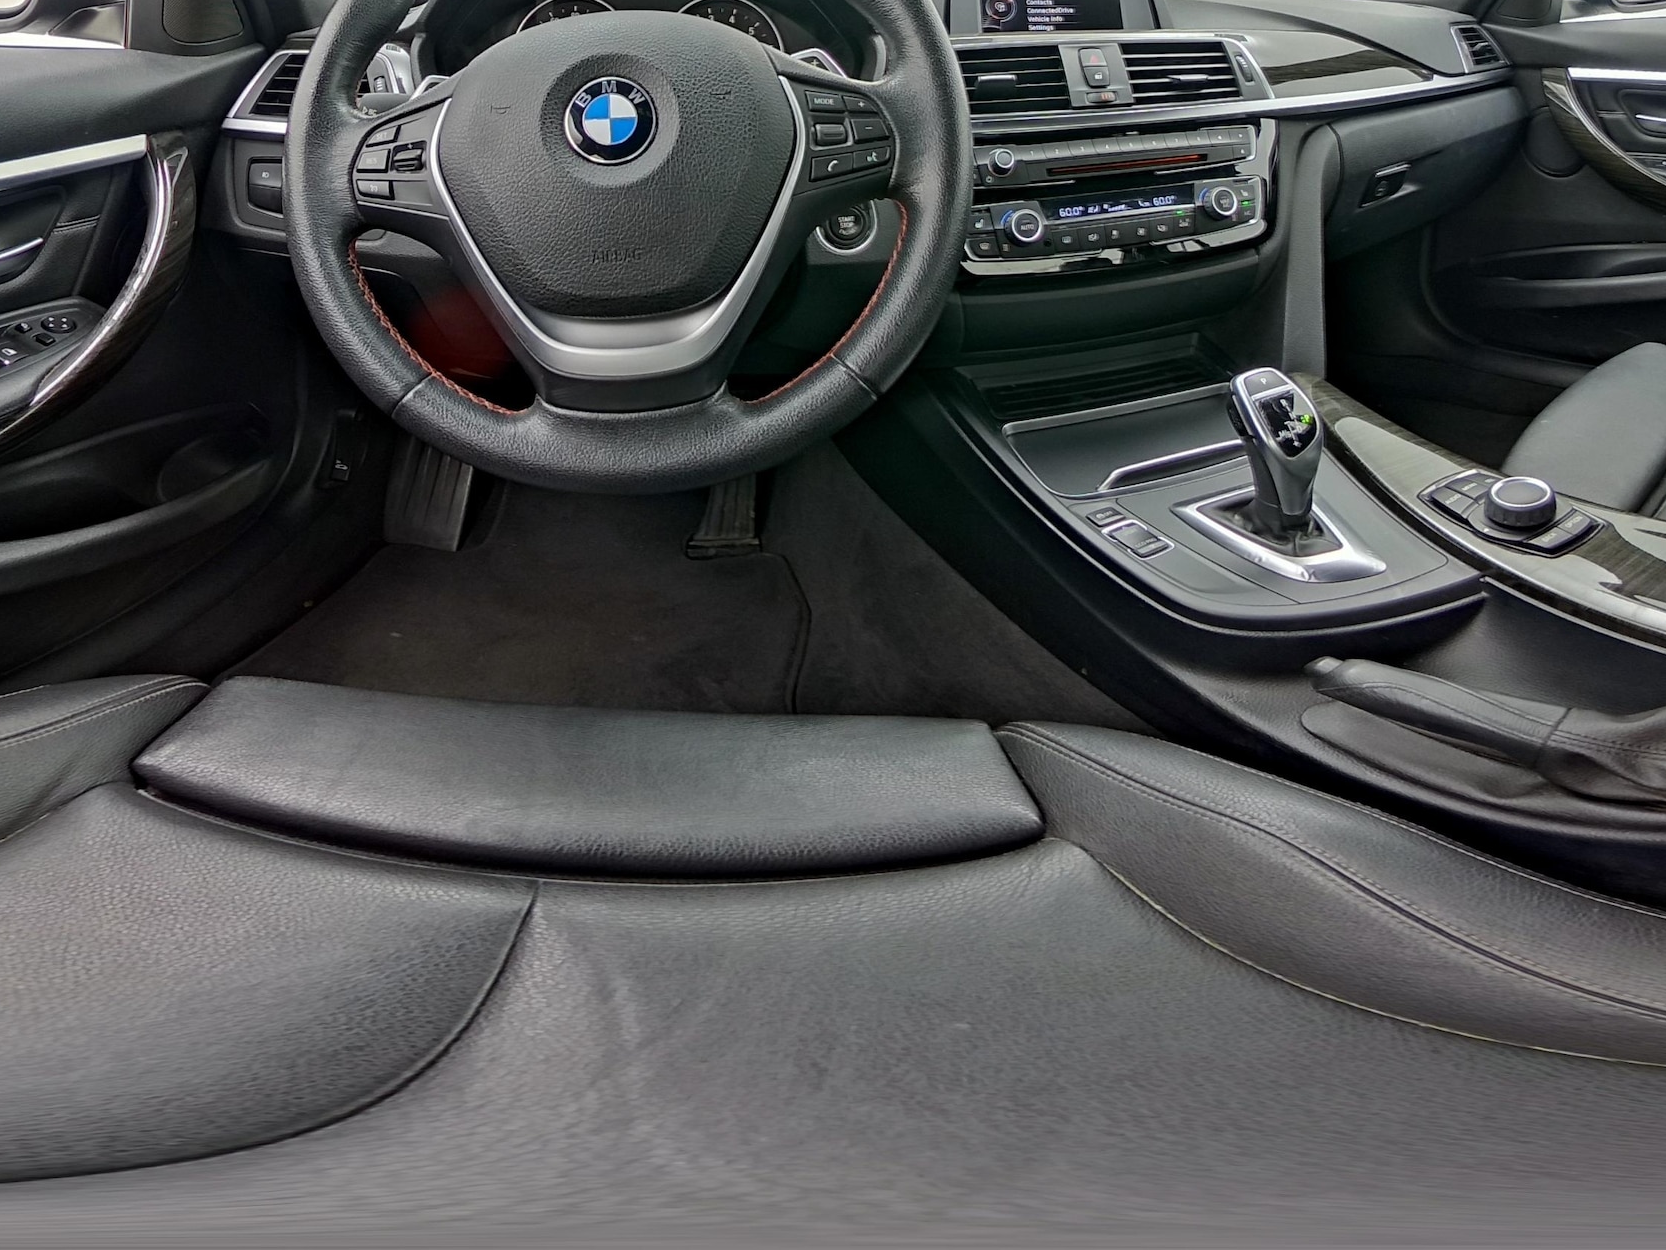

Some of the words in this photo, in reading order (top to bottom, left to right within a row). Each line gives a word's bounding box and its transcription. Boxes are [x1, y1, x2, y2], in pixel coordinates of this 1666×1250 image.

[728, 15, 735, 24] 4
[748, 27, 755, 35] 5
[1028, 24, 1054, 32] Settings
[574, 80, 646, 108] BMW
[814, 97, 835, 105] MODE
[1020, 223, 1035, 231] AUTO
[1564, 515, 1583, 529] OPTION
[1542, 532, 1556, 543] BACK
